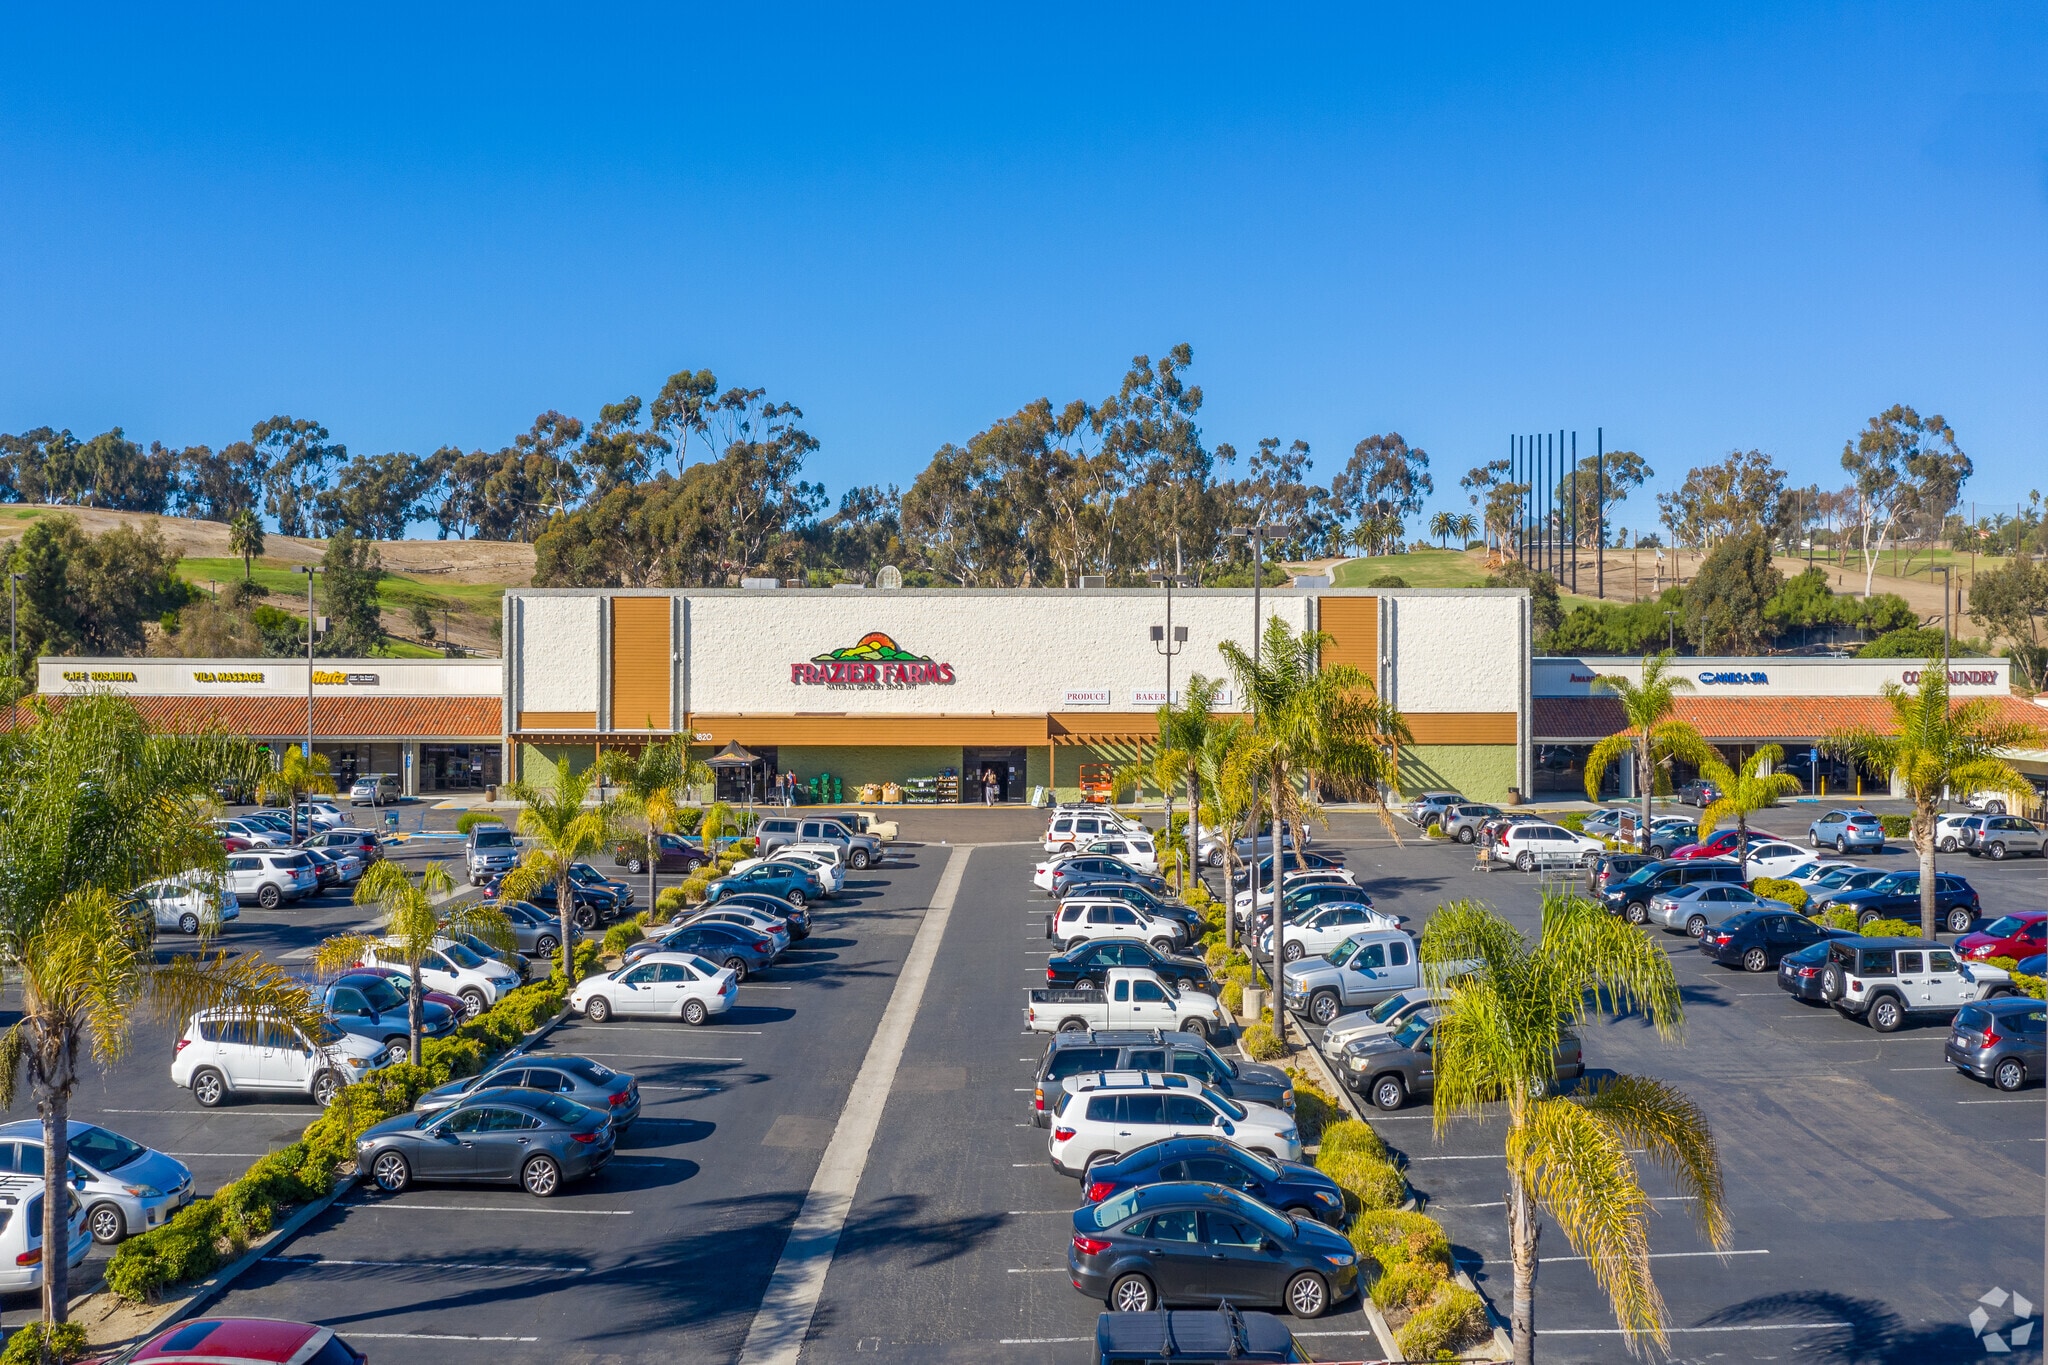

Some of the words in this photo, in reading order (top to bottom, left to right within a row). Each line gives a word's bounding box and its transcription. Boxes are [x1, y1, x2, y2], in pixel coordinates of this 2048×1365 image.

[62, 671, 85, 681] CAFE
[90, 671, 134, 681] ROSARITA
[193, 672, 214, 682] VILA
[217, 672, 262, 682] MASSAGE
[312, 670, 347, 684] Hertz
[791, 662, 878, 683] FRAZIER
[882, 662, 955, 683] FARMS
[1716, 672, 1743, 683] NAILS
[1750, 672, 1768, 683] SPA
[1946, 670, 1997, 684] AUNDRY
[826, 683, 855, 691] NATURAL
[857, 683, 885, 691] GROCERY
[1067, 692, 1106, 701] PRODUCE
[1135, 692, 1170, 701] BAKER
